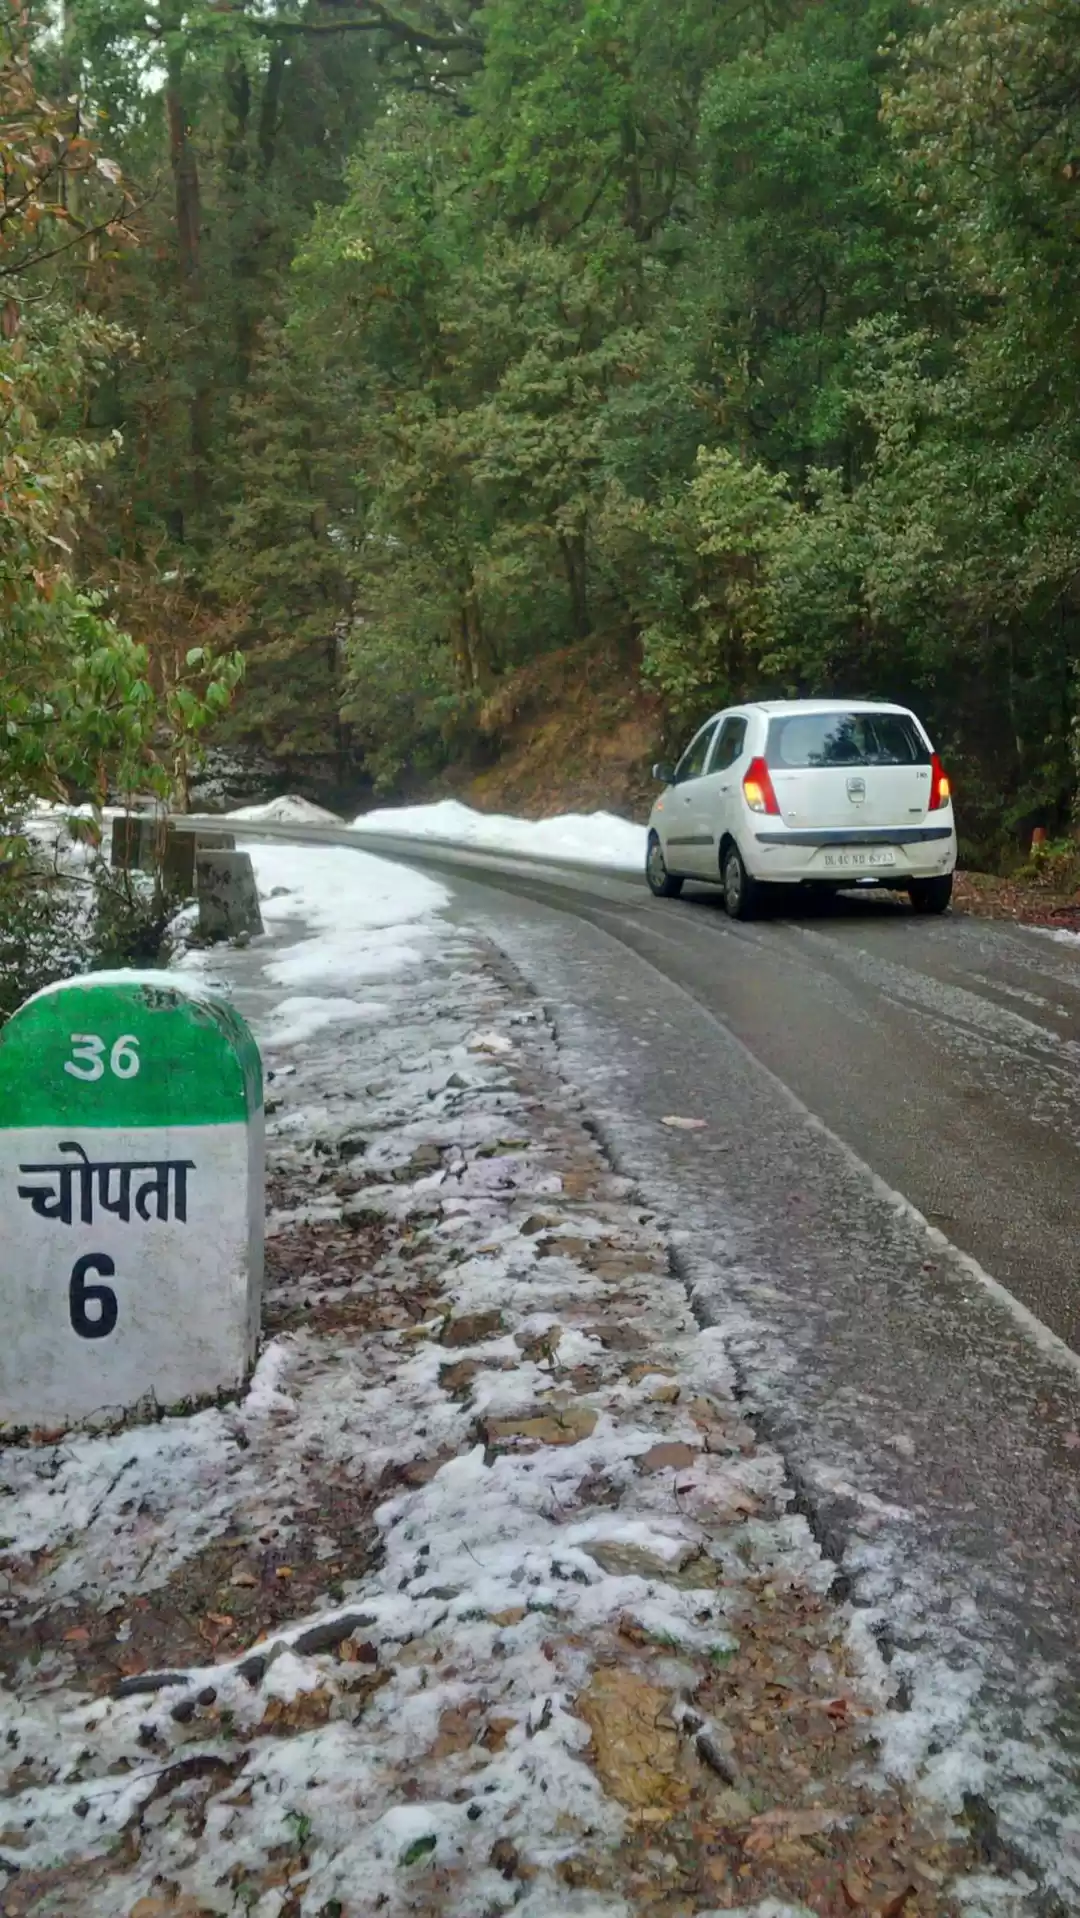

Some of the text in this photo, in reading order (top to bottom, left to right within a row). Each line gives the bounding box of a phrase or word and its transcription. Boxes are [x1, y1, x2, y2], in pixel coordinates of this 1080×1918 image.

[63, 1033, 141, 1081] 36
[17, 1141, 196, 1226] चोपता
[69, 1252, 118, 1340] 6
